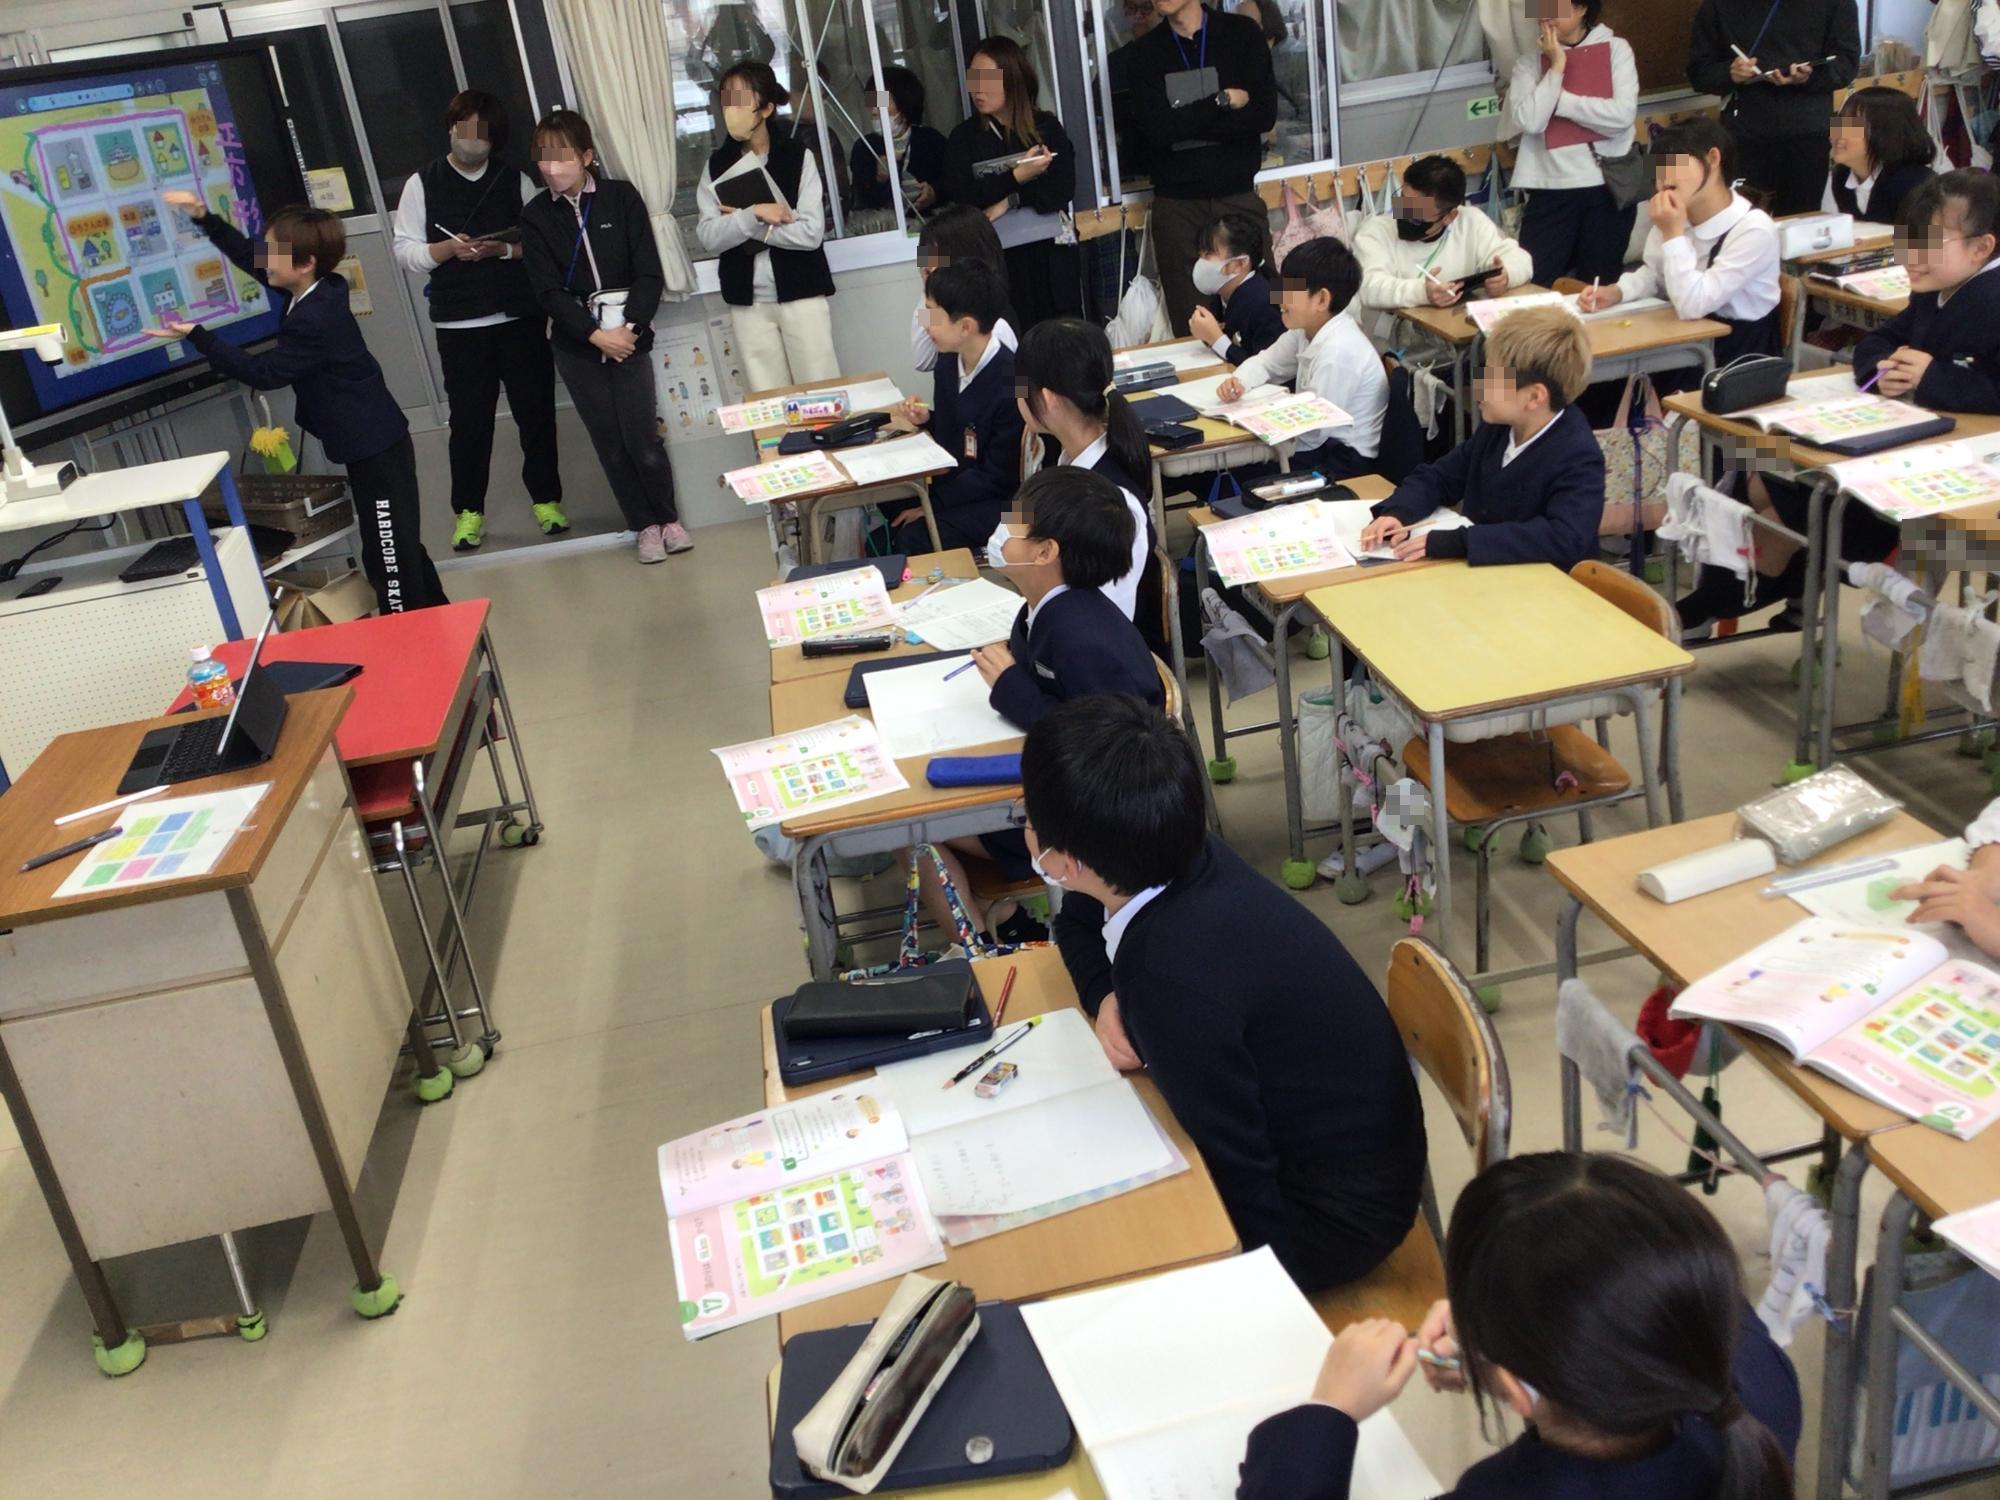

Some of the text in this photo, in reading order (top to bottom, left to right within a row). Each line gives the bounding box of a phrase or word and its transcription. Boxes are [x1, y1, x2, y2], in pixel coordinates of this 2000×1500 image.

[217, 122, 260, 234] 正方形
[376, 499, 404, 615] HARDCORE SKAT
[702, 1298, 723, 1314] 17
